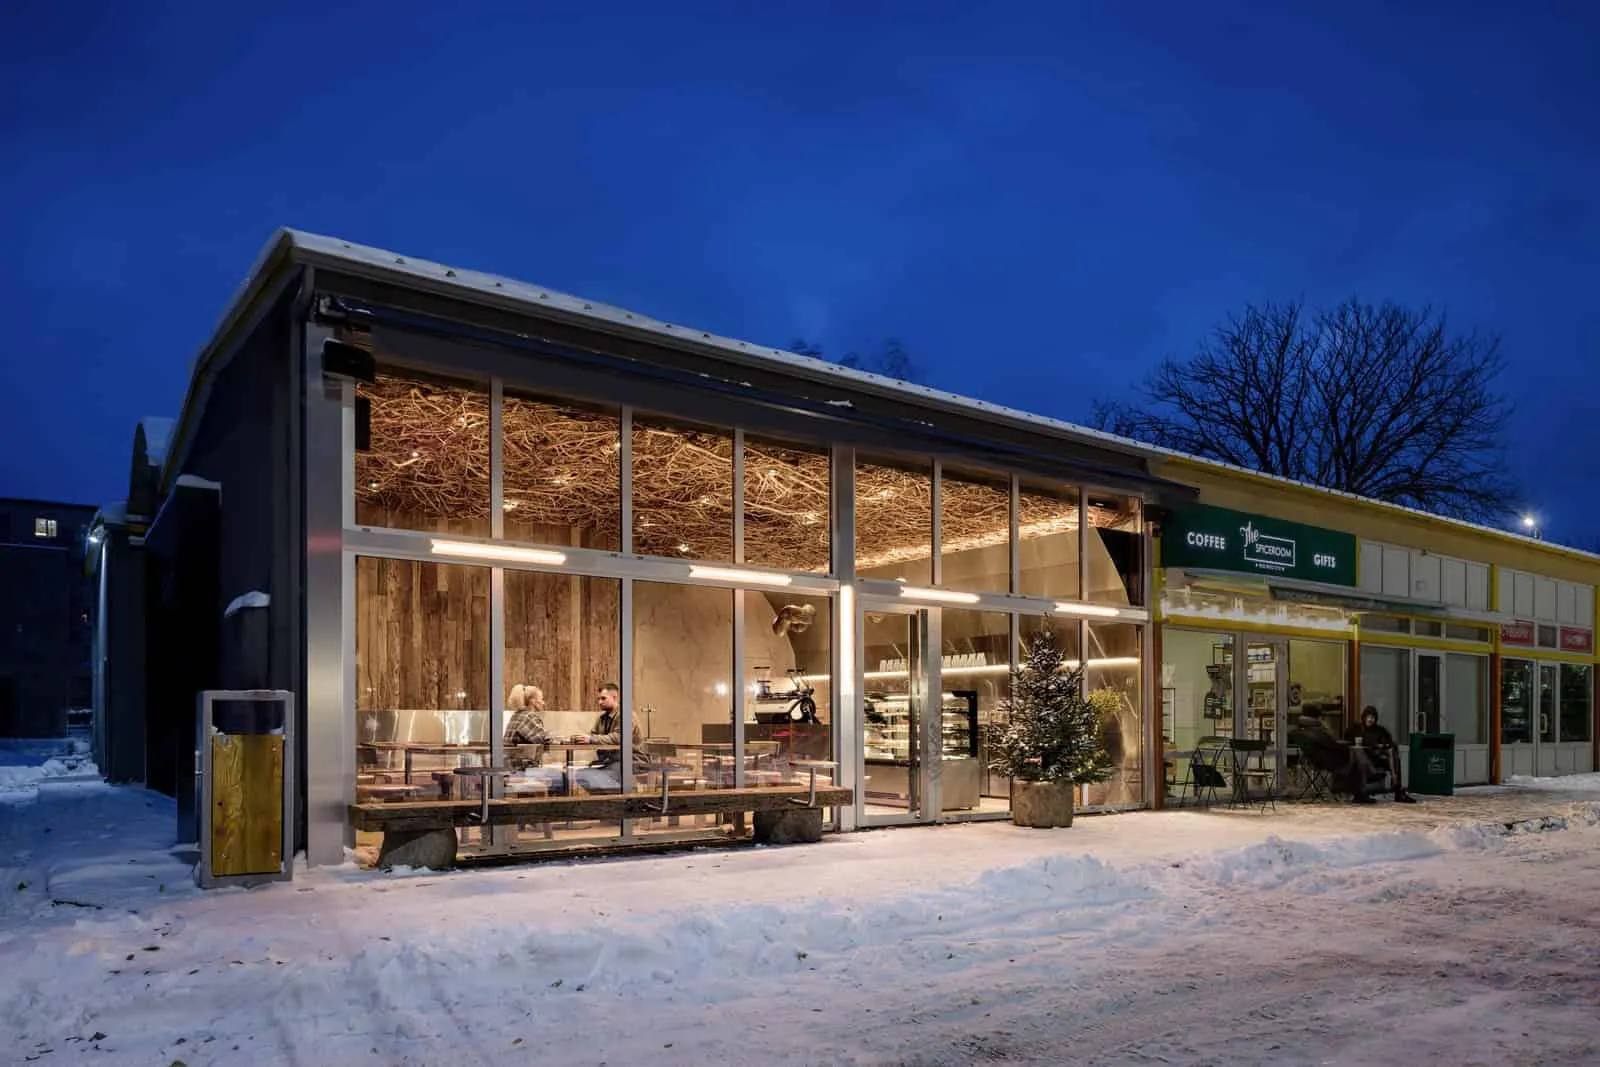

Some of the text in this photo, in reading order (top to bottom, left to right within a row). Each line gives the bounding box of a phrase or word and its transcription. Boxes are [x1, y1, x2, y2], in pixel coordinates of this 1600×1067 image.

[1187, 531, 1225, 549] COFFEE
[1240, 520, 1259, 547] The
[1255, 543, 1291, 558] SPICEROOM
[1313, 554, 1336, 568] GIFTS
